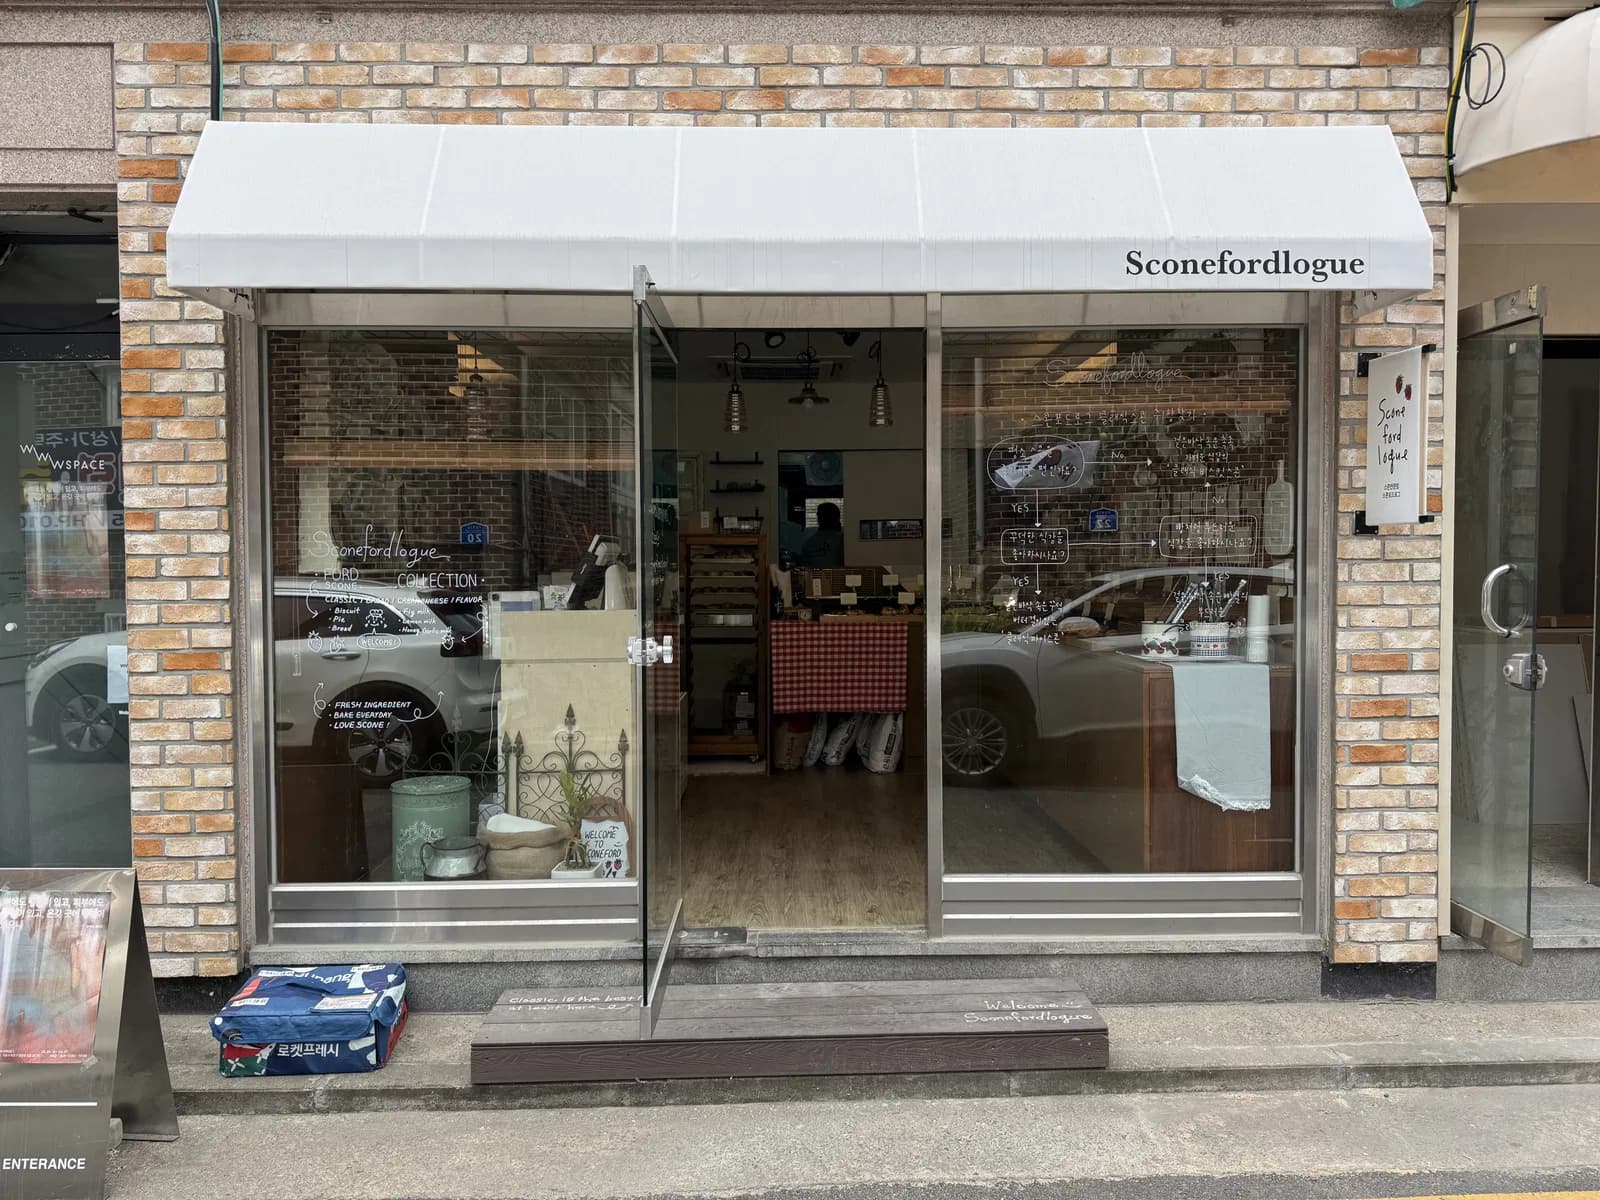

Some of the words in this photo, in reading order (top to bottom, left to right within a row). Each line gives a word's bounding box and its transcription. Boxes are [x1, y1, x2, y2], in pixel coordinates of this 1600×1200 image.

[1126, 249, 1365, 282] Sconefordlogue
[1377, 398, 1406, 427] Scone
[1382, 424, 1402, 445] ford
[1378, 445, 1409, 475] logue
[1010, 503, 1030, 513] YES
[1008, 531, 1036, 545] 꾸덕한
[1039, 531, 1064, 545] 식감을
[307, 524, 452, 568] Sconefordlogue
[324, 567, 359, 581] FORD
[397, 572, 478, 588] COLLECTION
[1012, 575, 1030, 587] YES
[325, 581, 358, 590] SCONE
[455, 596, 484, 604] FLAVOR
[334, 606, 361, 615] Biscuit
[332, 615, 347, 623] Pie
[331, 623, 354, 632] Bread
[362, 638, 397, 647] WELCOME!
[334, 701, 362, 709] FRESH
[363, 701, 412, 709] INGREDIENT
[334, 711, 355, 719] BAKE
[356, 711, 393, 719] EVERYDAY
[334, 721, 356, 729] LOVE
[356, 721, 385, 729] SCONE
[585, 830, 616, 840] WELCOME
[595, 839, 604, 849] TO
[586, 848, 622, 859] CONEFORD
[983, 999, 1059, 1010] Welcome
[276, 1042, 340, 1058] 로켓프레시
[2, 1157, 87, 1171] ENTERANCE
